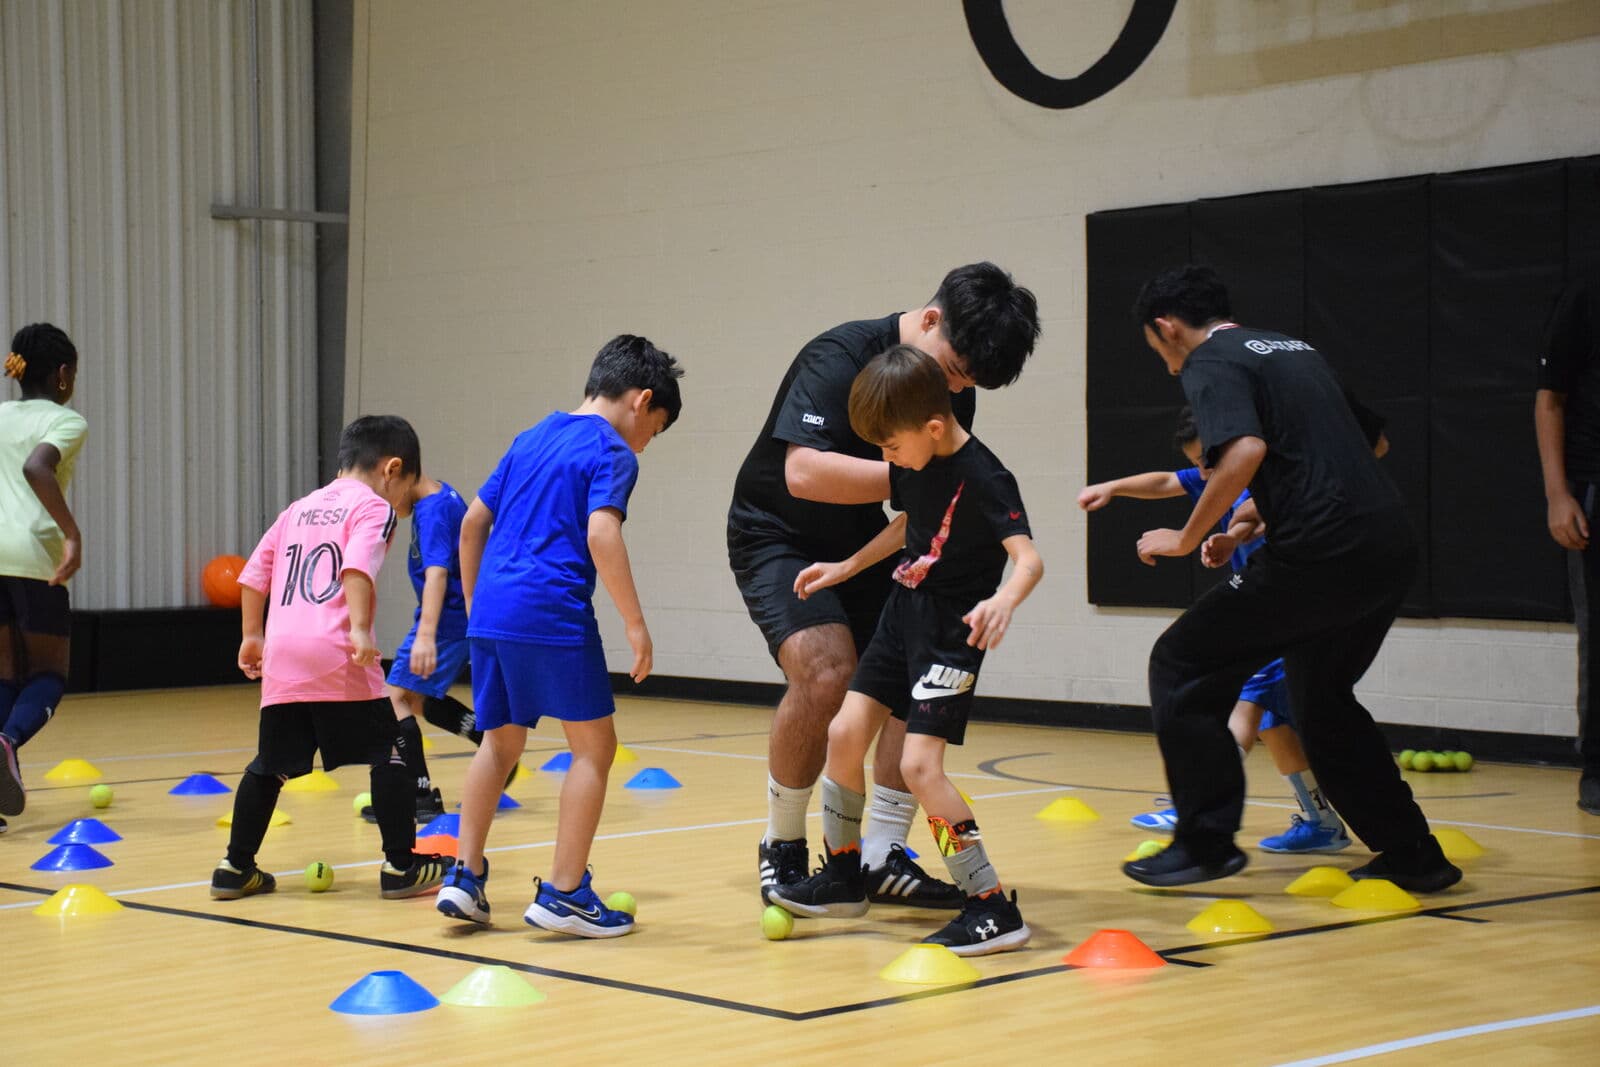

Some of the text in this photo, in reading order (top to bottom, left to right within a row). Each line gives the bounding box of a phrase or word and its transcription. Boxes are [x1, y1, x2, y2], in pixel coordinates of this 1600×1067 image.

[802, 413, 825, 426] COACH
[297, 507, 349, 527] MESSI
[281, 541, 343, 607] 10
